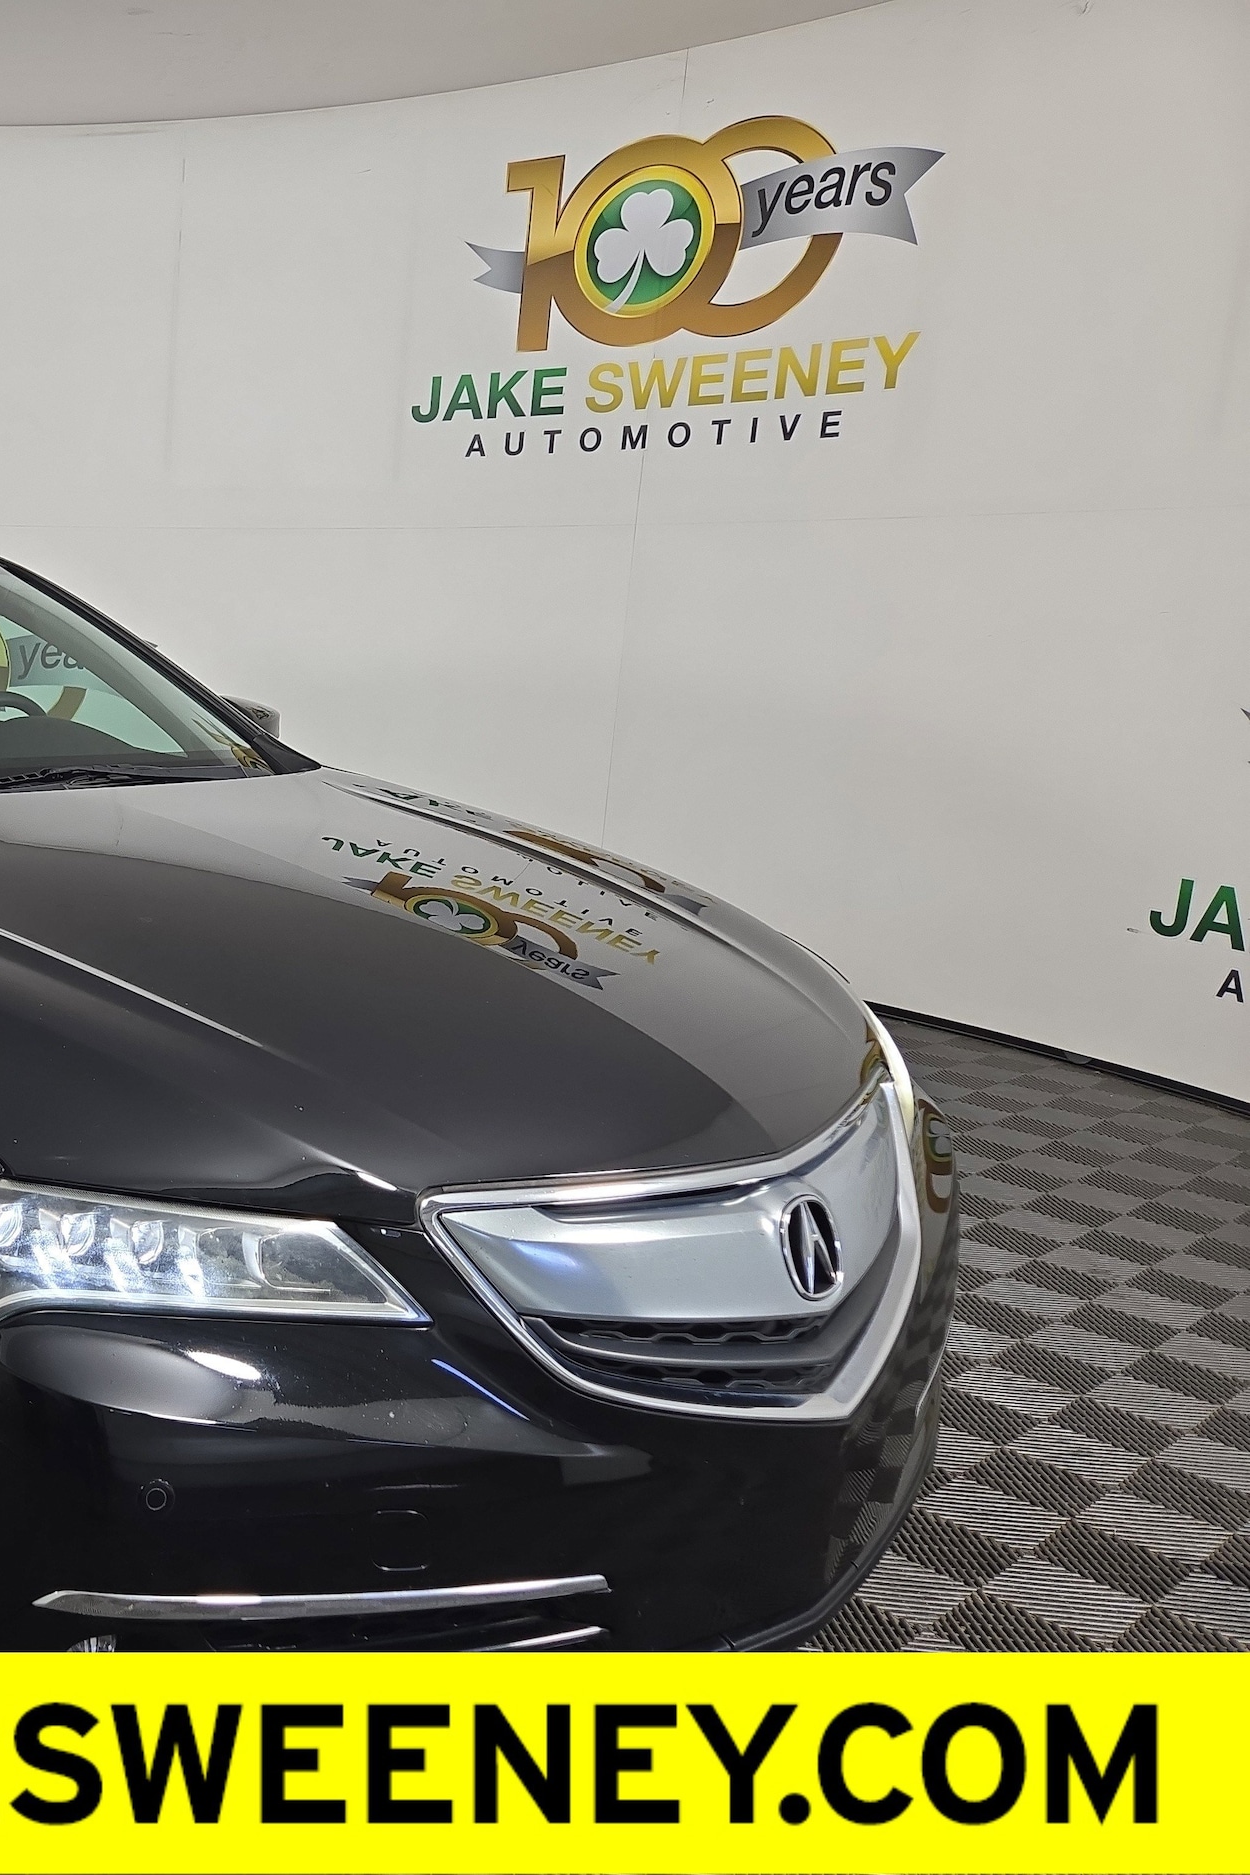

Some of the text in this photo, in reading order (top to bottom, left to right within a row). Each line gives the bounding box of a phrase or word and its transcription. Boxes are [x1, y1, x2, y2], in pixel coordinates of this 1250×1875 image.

[506, 115, 897, 352] 100 years
[411, 331, 922, 423] JAKE SWEENEY
[465, 409, 843, 458] AUTOMOTIVE
[17, 640, 86, 680] yea
[1149, 877, 1246, 952] JA
